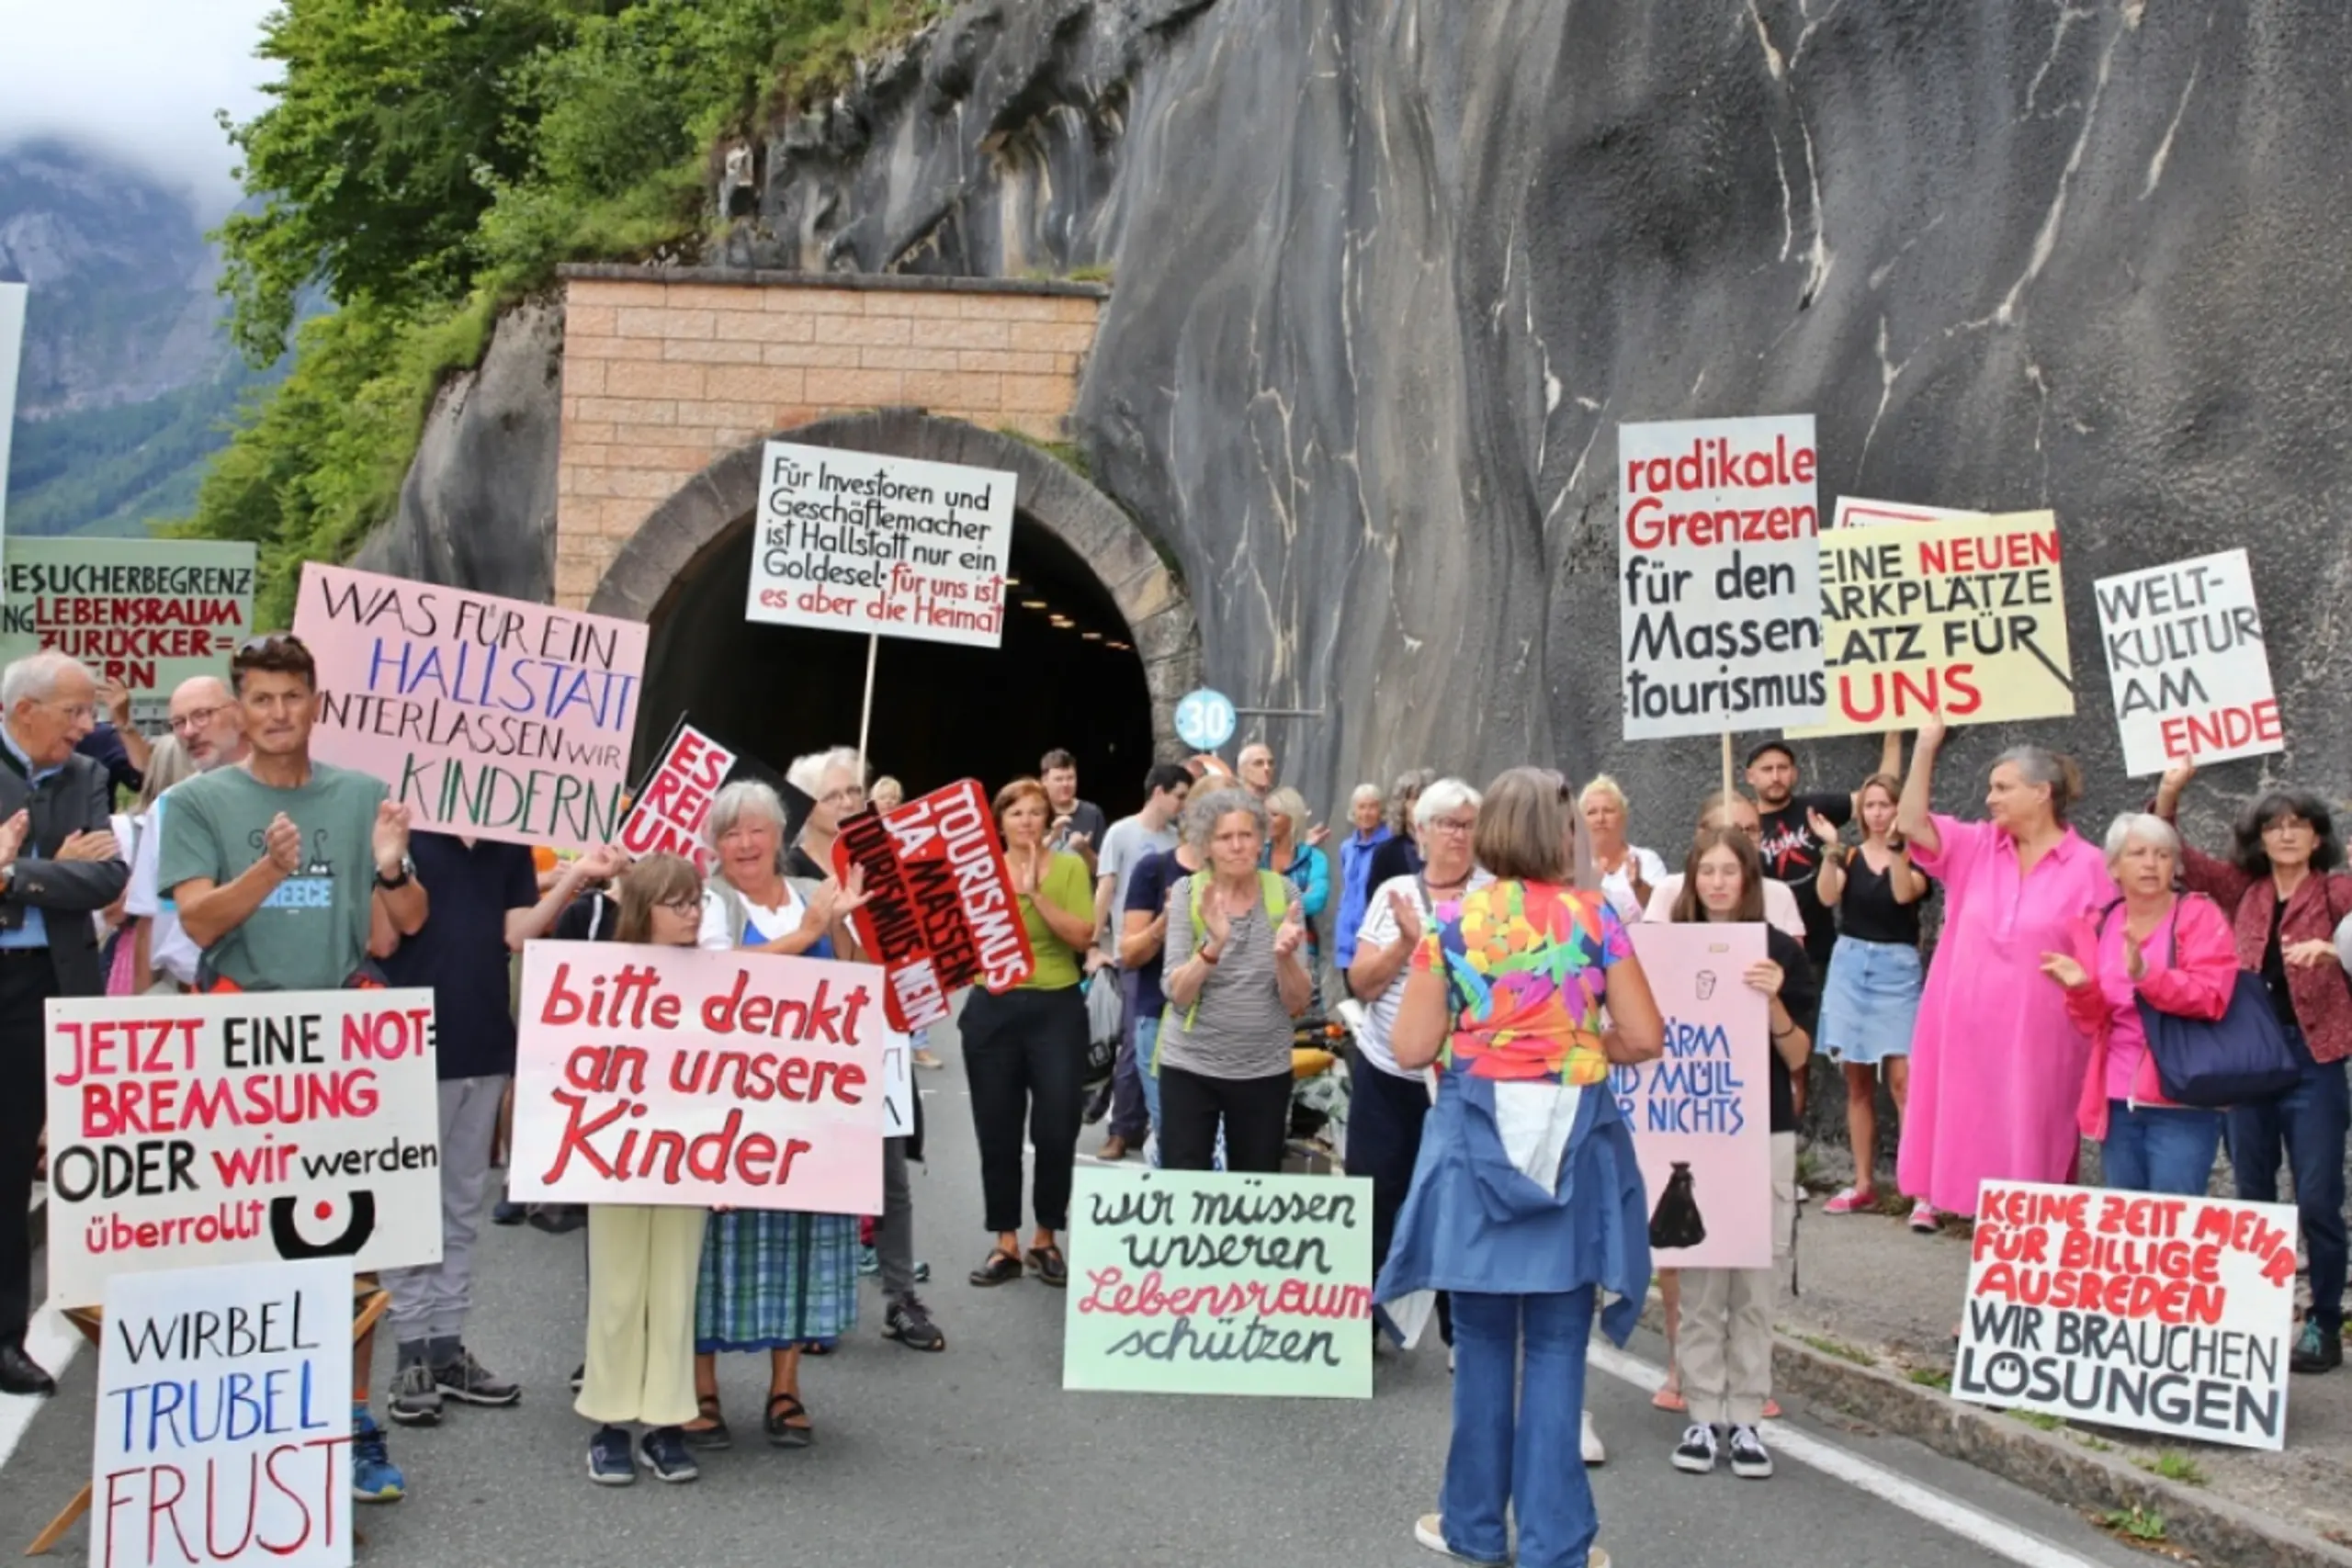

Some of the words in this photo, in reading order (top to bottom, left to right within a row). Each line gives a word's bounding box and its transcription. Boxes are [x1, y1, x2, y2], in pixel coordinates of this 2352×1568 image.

[773, 457, 812, 487] Für
[820, 461, 933, 504] Investoren
[945, 484, 991, 511] und
[1628, 434, 1817, 492] radikale
[770, 488, 991, 542] Geschäftemacher
[1626, 497, 1819, 549] Grenzen
[766, 519, 796, 547] ist
[801, 522, 910, 560] Hallstatt
[912, 546, 953, 566] nur
[959, 545, 997, 571] ein
[1819, 544, 1903, 584] EINE
[1919, 530, 2062, 575] NEUEN
[3, 563, 253, 595] ESUCHERBEGRENZ
[891, 562, 925, 595] für
[931, 580, 967, 599] uns
[975, 574, 1004, 604] ist
[1625, 556, 1692, 606] für
[1716, 549, 1795, 600] den
[1820, 570, 2052, 621] ARKPLÄTZE
[2098, 566, 2223, 625] WELT-
[36, 596, 243, 627] LEBENSRAUM
[322, 577, 436, 638] WAS
[454, 600, 527, 653] FÜR
[540, 616, 617, 670] EIN
[760, 588, 787, 609] es
[797, 583, 857, 616] aber
[866, 590, 907, 620] die
[914, 596, 1004, 634] Heimat
[2109, 606, 2262, 671] KULTUR
[369, 637, 638, 731] HALLSTATT
[1627, 665, 1826, 718] tourismus
[1839, 664, 1982, 722] UNS
[2120, 667, 2210, 719] AM
[1185, 700, 1227, 740] 30
[2160, 698, 2283, 759] ENDE
[567, 742, 620, 769] WIR
[668, 732, 728, 790] ES
[399, 752, 621, 845] KINDERN
[643, 766, 713, 833] REI
[934, 783, 1028, 988] TOURISMUS
[540, 963, 682, 1030] bitte
[701, 968, 871, 1046] denkt
[890, 957, 950, 1032] NEIN
[54, 1017, 205, 1087] JETZT
[223, 1014, 323, 1067] EINE
[1663, 1015, 1731, 1058] ÄRM
[81, 1068, 379, 1137] BREMSUNG
[564, 1044, 649, 1094] an
[669, 1049, 866, 1105] unsere
[1648, 1060, 1744, 1097] MÜLL
[541, 1087, 813, 1186] Kinder
[1648, 1097, 1744, 1136] NICHTS
[53, 1140, 199, 1202] ODER
[211, 1133, 299, 1188] wir
[302, 1136, 437, 1179] werden
[85, 1199, 265, 1254] überrollt
[1089, 1172, 1174, 1226] wir
[1191, 1179, 1357, 1228] müssen
[1120, 1233, 1331, 1275] unseren
[1973, 1224, 2049, 1265] FÜR
[2060, 1228, 2222, 1283] BILLIGE
[1981, 1190, 2090, 1229] KEINE
[2098, 1196, 2186, 1238] ZEIT
[2192, 1205, 2298, 1288] MEHR
[1078, 1266, 1373, 1319] Lebensraum
[1975, 1261, 2225, 1325] AUSREDEN
[119, 1290, 320, 1364] WIRBEL
[1105, 1314, 1341, 1367] schützen
[1970, 1299, 2043, 1352] WIR
[2057, 1311, 2278, 1383] BRAUCHEN
[107, 1359, 330, 1452] TRUBEL
[1961, 1347, 2281, 1438] LÖSUNGEN
[104, 1436, 353, 1568] FRUST
